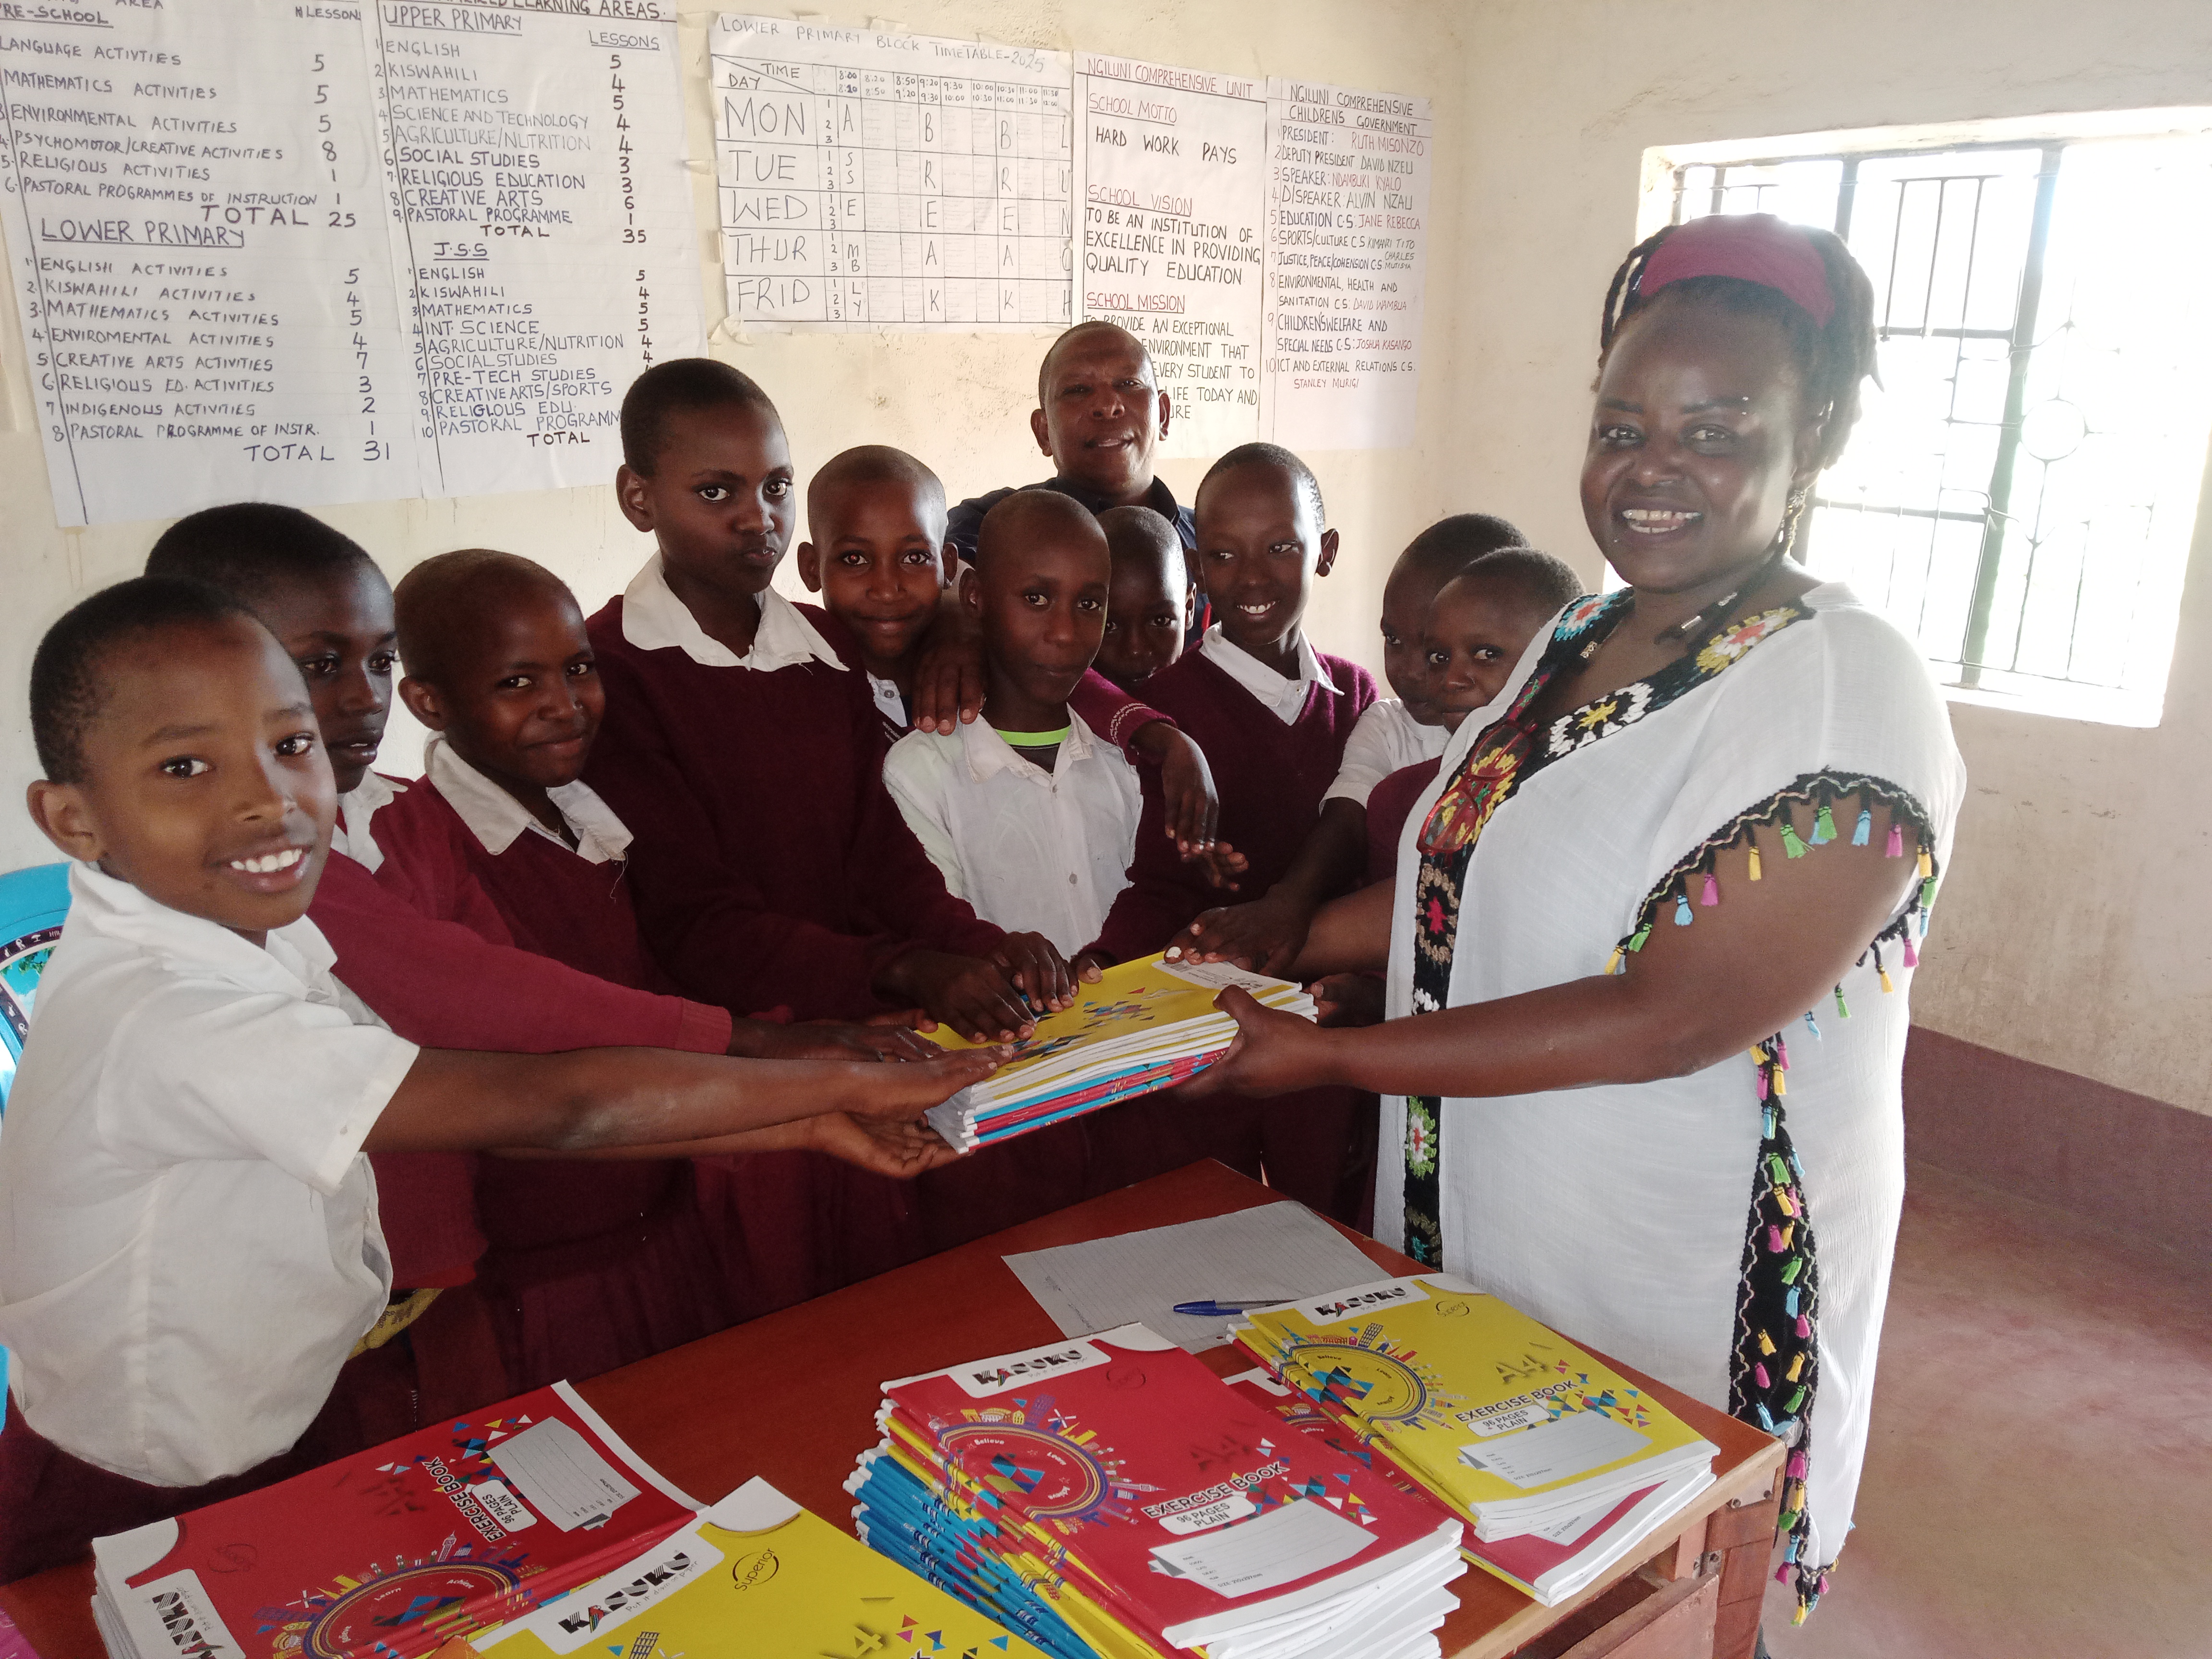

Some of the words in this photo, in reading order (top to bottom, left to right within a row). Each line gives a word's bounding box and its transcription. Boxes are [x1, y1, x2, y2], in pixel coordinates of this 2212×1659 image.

[384, 5, 445, 28] UPPER
[453, 11, 521, 32] PRIMARY
[599, 0, 666, 20] AREAS.
[0, 36, 82, 58] LANGUAGE
[589, 30, 659, 50] LESSONS
[797, 25, 860, 44] PRIMARY
[877, 34, 919, 51] BLOCK
[386, 40, 460, 58] ENGLISH
[389, 64, 478, 82] KISWAHILI
[729, 74, 760, 88] DAY
[762, 63, 800, 79] TIME
[1088, 58, 1131, 79] NGILUNI
[1135, 65, 1217, 93] COMPREHENSIVE
[1226, 81, 1253, 97] UNIT
[4, 69, 112, 93] MATHEMATICS
[134, 83, 217, 100] ACTIVITIES
[896, 76, 915, 86] 8:50
[919, 78, 938, 87] 9:20
[944, 81, 963, 91] 9:30
[973, 83, 994, 92] 10:00
[390, 86, 509, 103] MATHEMATICS
[895, 89, 915, 100] 9:20
[1290, 84, 1329, 105] NGILUNI
[1336, 92, 1413, 116] COMPREHENSIVE
[11, 104, 137, 129] ENVIRONMENTAL
[392, 105, 458, 122] SCIENCE
[464, 109, 493, 124] AND
[497, 110, 589, 129] TECHNOLOGY
[725, 96, 805, 138] MON
[1089, 93, 1133, 115] SCHOOL
[1138, 100, 1178, 123] MOTTO
[1357, 115, 1417, 136] GOVERNMENT
[394, 126, 591, 151] AGRICULTURE/NUTRITION
[1096, 126, 1127, 146] HARD
[1143, 134, 1179, 156] WORK
[1202, 142, 1237, 164] PAYS
[1352, 132, 1374, 151] RUTH
[1378, 136, 1424, 156] MISONZO
[20, 151, 107, 174] RELIGIOUS
[202, 146, 283, 160] ACTIVITIES
[400, 148, 464, 166] SOCIAL
[470, 152, 540, 168] STUDIES
[1282, 144, 1311, 164] DEPUTY
[1360, 155, 1384, 171] DAVID
[1388, 160, 1413, 174] NZEU
[728, 150, 797, 182] TUE
[24, 176, 92, 197] PASTORAL
[99, 183, 193, 202] PROGRAMMES
[228, 193, 317, 206] INSTRUCTION
[496, 172, 586, 190] EDUCATION
[1332, 172, 1370, 188] NDAMBUKI
[1376, 175, 1402, 191] KYALO
[405, 189, 487, 207] CREATIVE
[496, 190, 543, 207] ARTS
[733, 190, 808, 223] WED
[1088, 184, 1140, 207] SCHOOL
[1151, 193, 1192, 216] VISION
[1346, 191, 1376, 209] ALVIN
[1384, 194, 1413, 210] NZAU
[201, 204, 309, 226] TOTAL
[329, 211, 357, 227] 25
[407, 208, 478, 223] PASTORAL
[486, 208, 573, 224] PROGRAMME
[1086, 207, 1102, 223] TO
[1107, 210, 1120, 225] BE
[1126, 214, 1143, 229] AN
[1152, 218, 1227, 240] INSTITUTION
[1239, 227, 1253, 243] OF
[1280, 210, 1332, 228] EDUCATION
[1358, 214, 1382, 228] JANE
[1387, 216, 1421, 230] REBECCA
[42, 218, 134, 242] LOWER
[146, 220, 245, 246] PRIMARY
[480, 224, 551, 239] TOTAL
[623, 228, 647, 244] 35
[728, 234, 807, 265] THUR
[1086, 230, 1165, 255] EXCELLENCE
[1172, 238, 1185, 256] IN
[1194, 241, 1261, 265] PROVIDING
[1396, 239, 1415, 250] TITO
[1384, 251, 1415, 261] CHARLES
[41, 257, 113, 274] ENGLISH
[132, 264, 228, 277] ACTIVITIES
[419, 266, 485, 281] ENGLISH
[1086, 252, 1149, 276] QUALITY
[1167, 262, 1242, 285] EDUCATION
[46, 278, 138, 297] KISWAHILI
[737, 276, 810, 312] FRID
[1347, 277, 1374, 292] HEALTH
[1381, 282, 1398, 292] AND
[1087, 292, 1133, 311] SCHOOL
[1138, 294, 1185, 313] MISSION
[1278, 296, 1329, 309] SANITATION
[1353, 298, 1374, 311] DAVID
[1376, 300, 1407, 311] WAMBUA
[47, 300, 169, 322] MATHEMATICS
[189, 309, 279, 326] ACTIVITIES
[51, 328, 172, 346] ENVIROMENTAL
[460, 319, 540, 335] SCIENCE
[1173, 320, 1234, 337] EXCEPTIONAL
[1221, 344, 1250, 360] THAT
[1277, 337, 1310, 352] SPECIAL
[1356, 338, 1380, 350] JOSHUA
[1382, 340, 1412, 351] KASANGO
[56, 353, 135, 370] CREATIVE
[195, 357, 274, 372] ACTIVITIES
[1188, 364, 1232, 380] STUDENT
[1277, 358, 1291, 373] ICT
[1313, 360, 1350, 373] EXTERNAL
[1355, 360, 1397, 372] RELATIONS
[60, 374, 152, 392] RELIGIOUS
[433, 370, 521, 387] PRE-TECH
[1294, 378, 1327, 389] STANLEY
[1332, 378, 1359, 388] MURIGI
[1197, 386, 1234, 402] TODAY
[1237, 388, 1257, 406] AND
[65, 403, 163, 416] INDIGENOUS
[527, 432, 590, 447] TOTAL
[244, 444, 335, 462] TOTAL
[363, 442, 390, 461] 31
[1314, 1286, 1407, 1318] KASUKU
[972, 1350, 1082, 1387] KASUKU
[1455, 1394, 1532, 1423] EXERCISE
[1531, 1380, 1578, 1402] BOOK
[1482, 1419, 1496, 1428] 96
[1495, 1409, 1529, 1424] PAGES
[1498, 1417, 1528, 1430] PLAIN
[422, 1456, 462, 1494] BOOK
[1142, 1483, 1234, 1518] EXERCISE
[1234, 1461, 1290, 1490] BOOK
[481, 1493, 507, 1517] PAGES
[496, 1494, 523, 1515] PLAIN
[1191, 1503, 1230, 1521] PAGES
[450, 1491, 506, 1542] EXERCISE
[1193, 1512, 1230, 1527] PLAIN
[734, 1547, 776, 1591] Superior
[558, 1552, 690, 1634] KASUKU
[625, 1600, 642, 1611] Put
